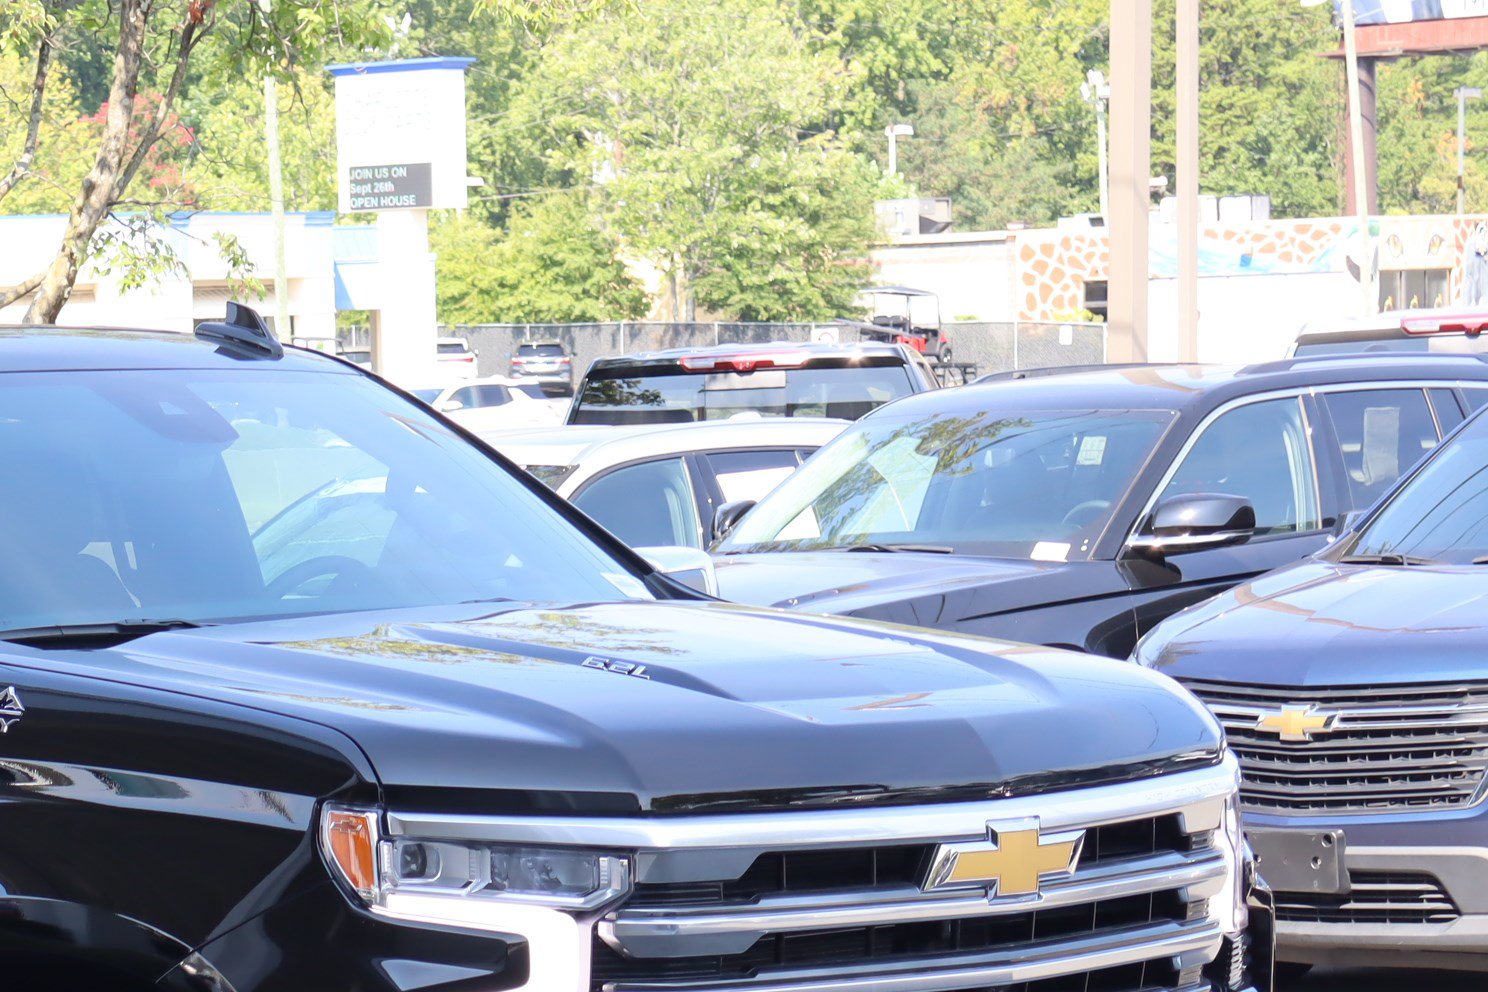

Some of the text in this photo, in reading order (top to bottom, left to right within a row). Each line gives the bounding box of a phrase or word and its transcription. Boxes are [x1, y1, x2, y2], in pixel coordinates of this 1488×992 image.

[350, 166, 407, 180] JOIN US ON
[350, 181, 395, 196] Sept 26th
[350, 195, 417, 208] OPEN HOUSE
